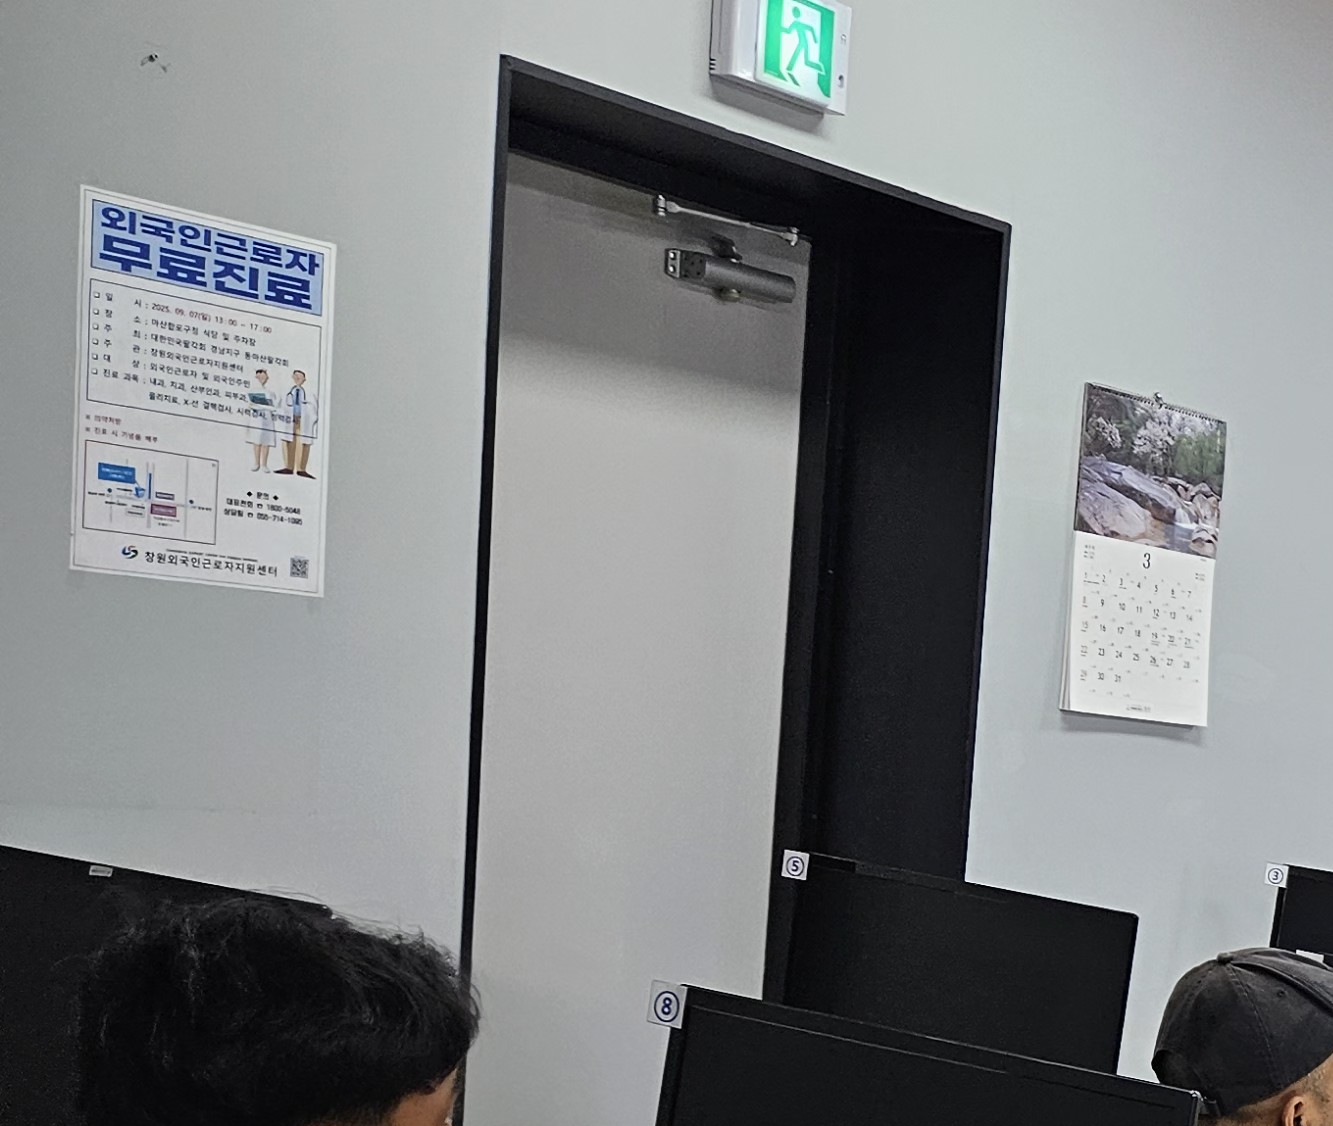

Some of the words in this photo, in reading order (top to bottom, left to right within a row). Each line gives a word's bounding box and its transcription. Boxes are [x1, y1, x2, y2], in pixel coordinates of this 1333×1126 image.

[101, 206, 320, 276] 외국인근로자
[99, 233, 312, 310] 무료진료
[203, 329, 219, 339] 식당
[233, 334, 256, 347] 주차장
[103, 368, 119, 379] 진료
[150, 362, 198, 379] 외국인근로자
[144, 551, 278, 578] 창원외국인근로자지원센터
[1142, 552, 1151, 569] 3
